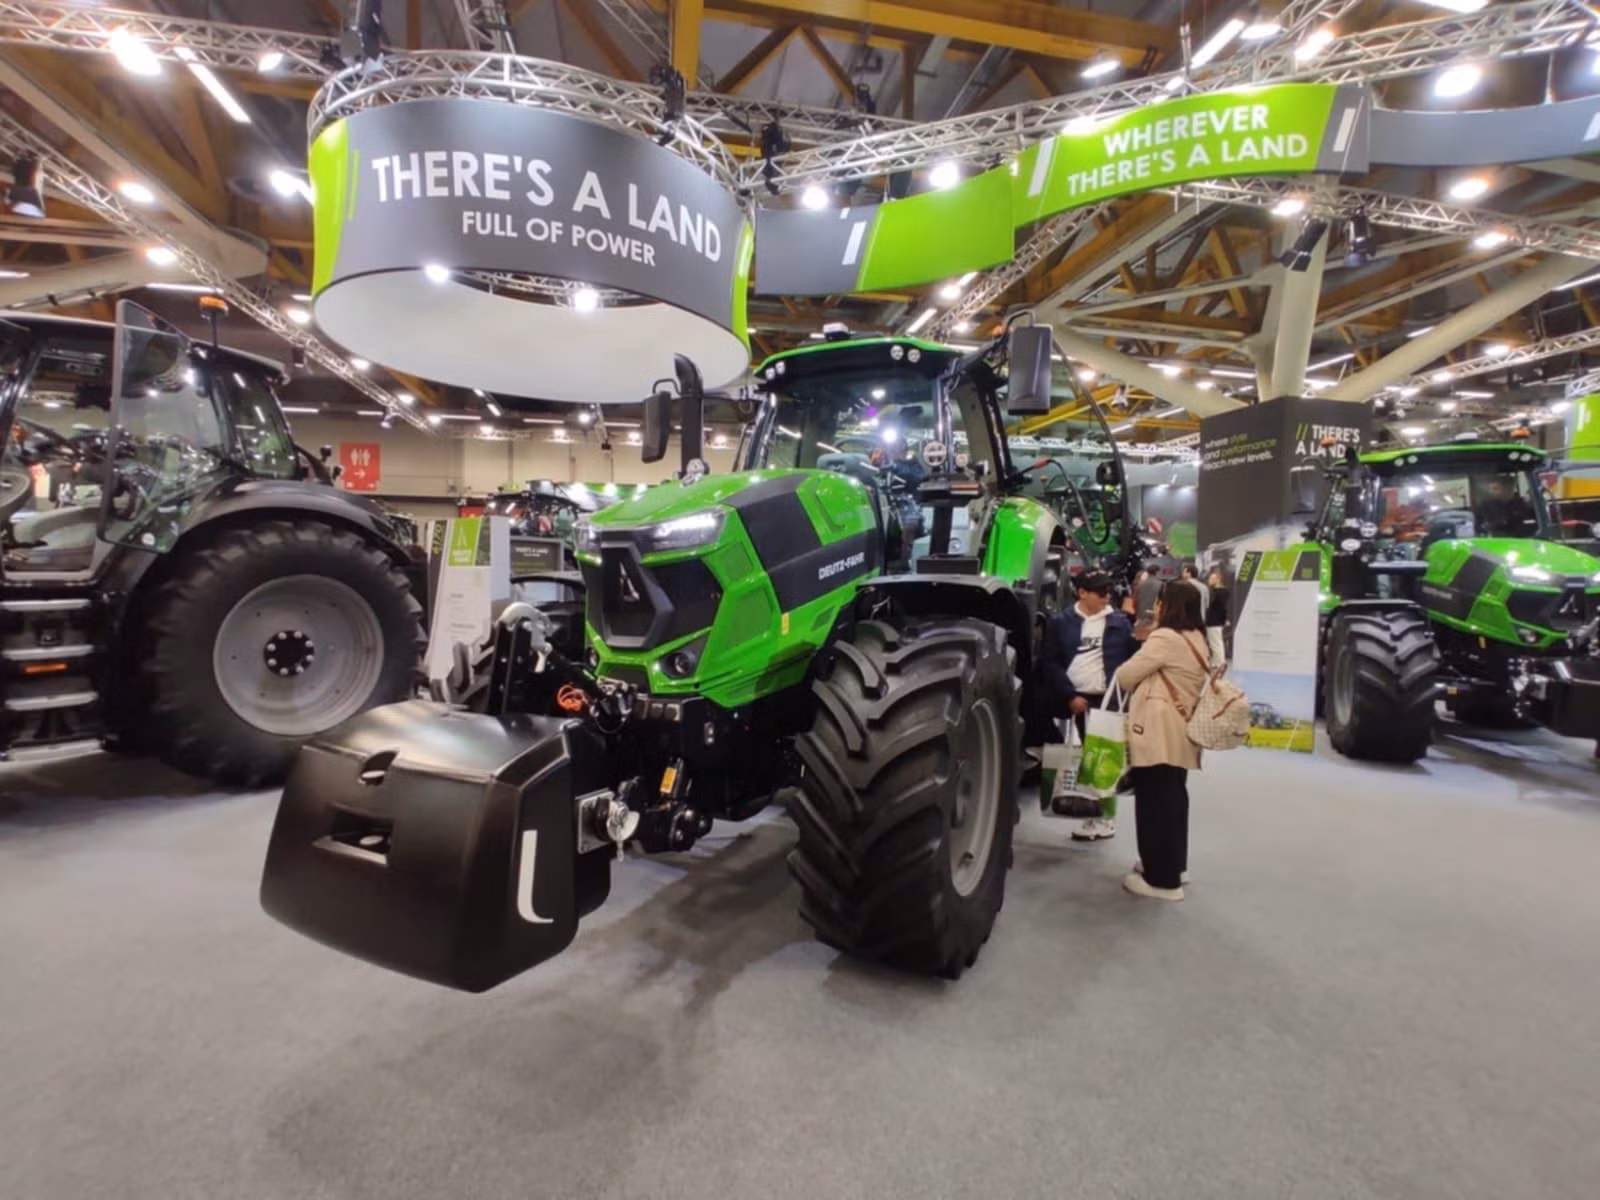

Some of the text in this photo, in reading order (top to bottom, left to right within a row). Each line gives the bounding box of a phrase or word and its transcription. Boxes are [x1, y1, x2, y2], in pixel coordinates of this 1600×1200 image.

[1103, 104, 1270, 159] WHEREVER
[1067, 133, 1309, 197] THERE'S A LAND
[371, 150, 722, 263] THERE'S A LAND
[462, 211, 657, 267] FULL OF POWER
[1295, 439, 1307, 457] A
